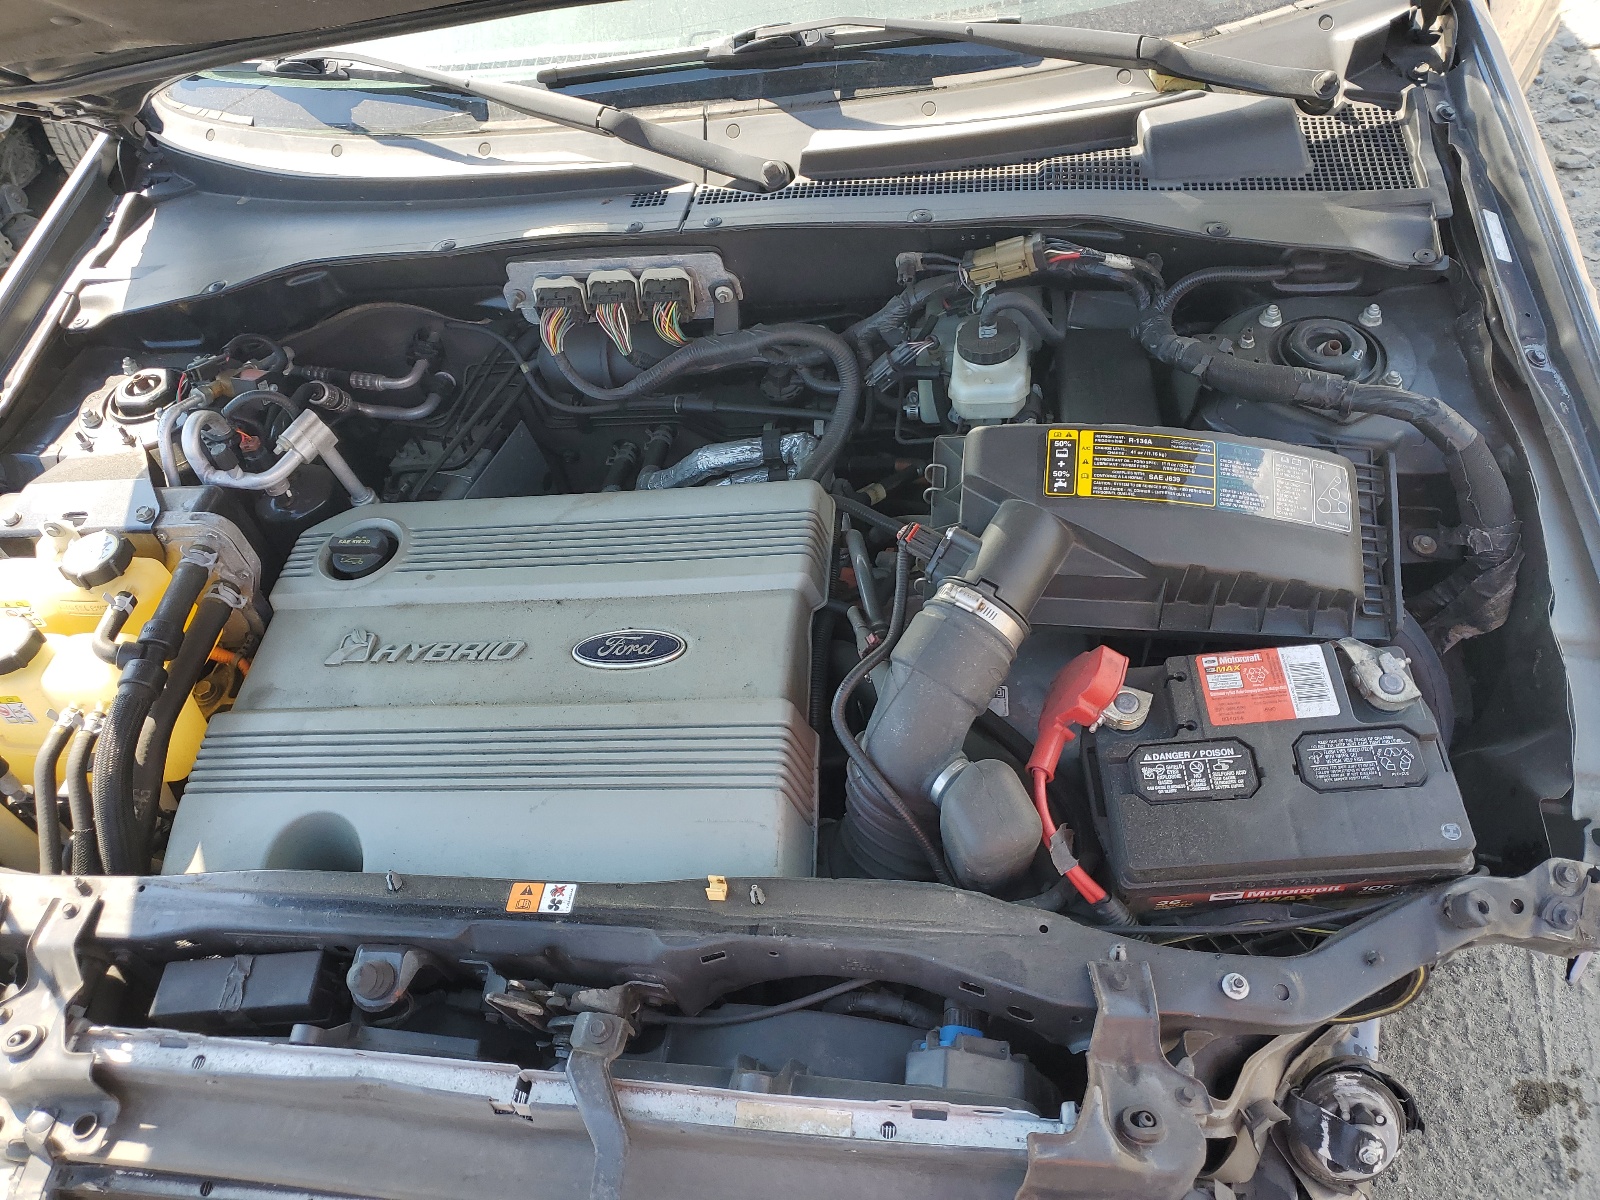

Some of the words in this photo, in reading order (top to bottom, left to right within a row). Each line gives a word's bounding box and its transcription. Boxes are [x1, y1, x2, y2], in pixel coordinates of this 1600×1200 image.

[597, 634, 656, 658] Ford
[1219, 653, 1262, 665] Motorcraft
[1215, 664, 1242, 673] MAX
[1152, 751, 1191, 761] DANGER
[1199, 748, 1235, 758] POISON
[1246, 884, 1343, 898] Motorcraft
[1259, 894, 1314, 903] MAX
